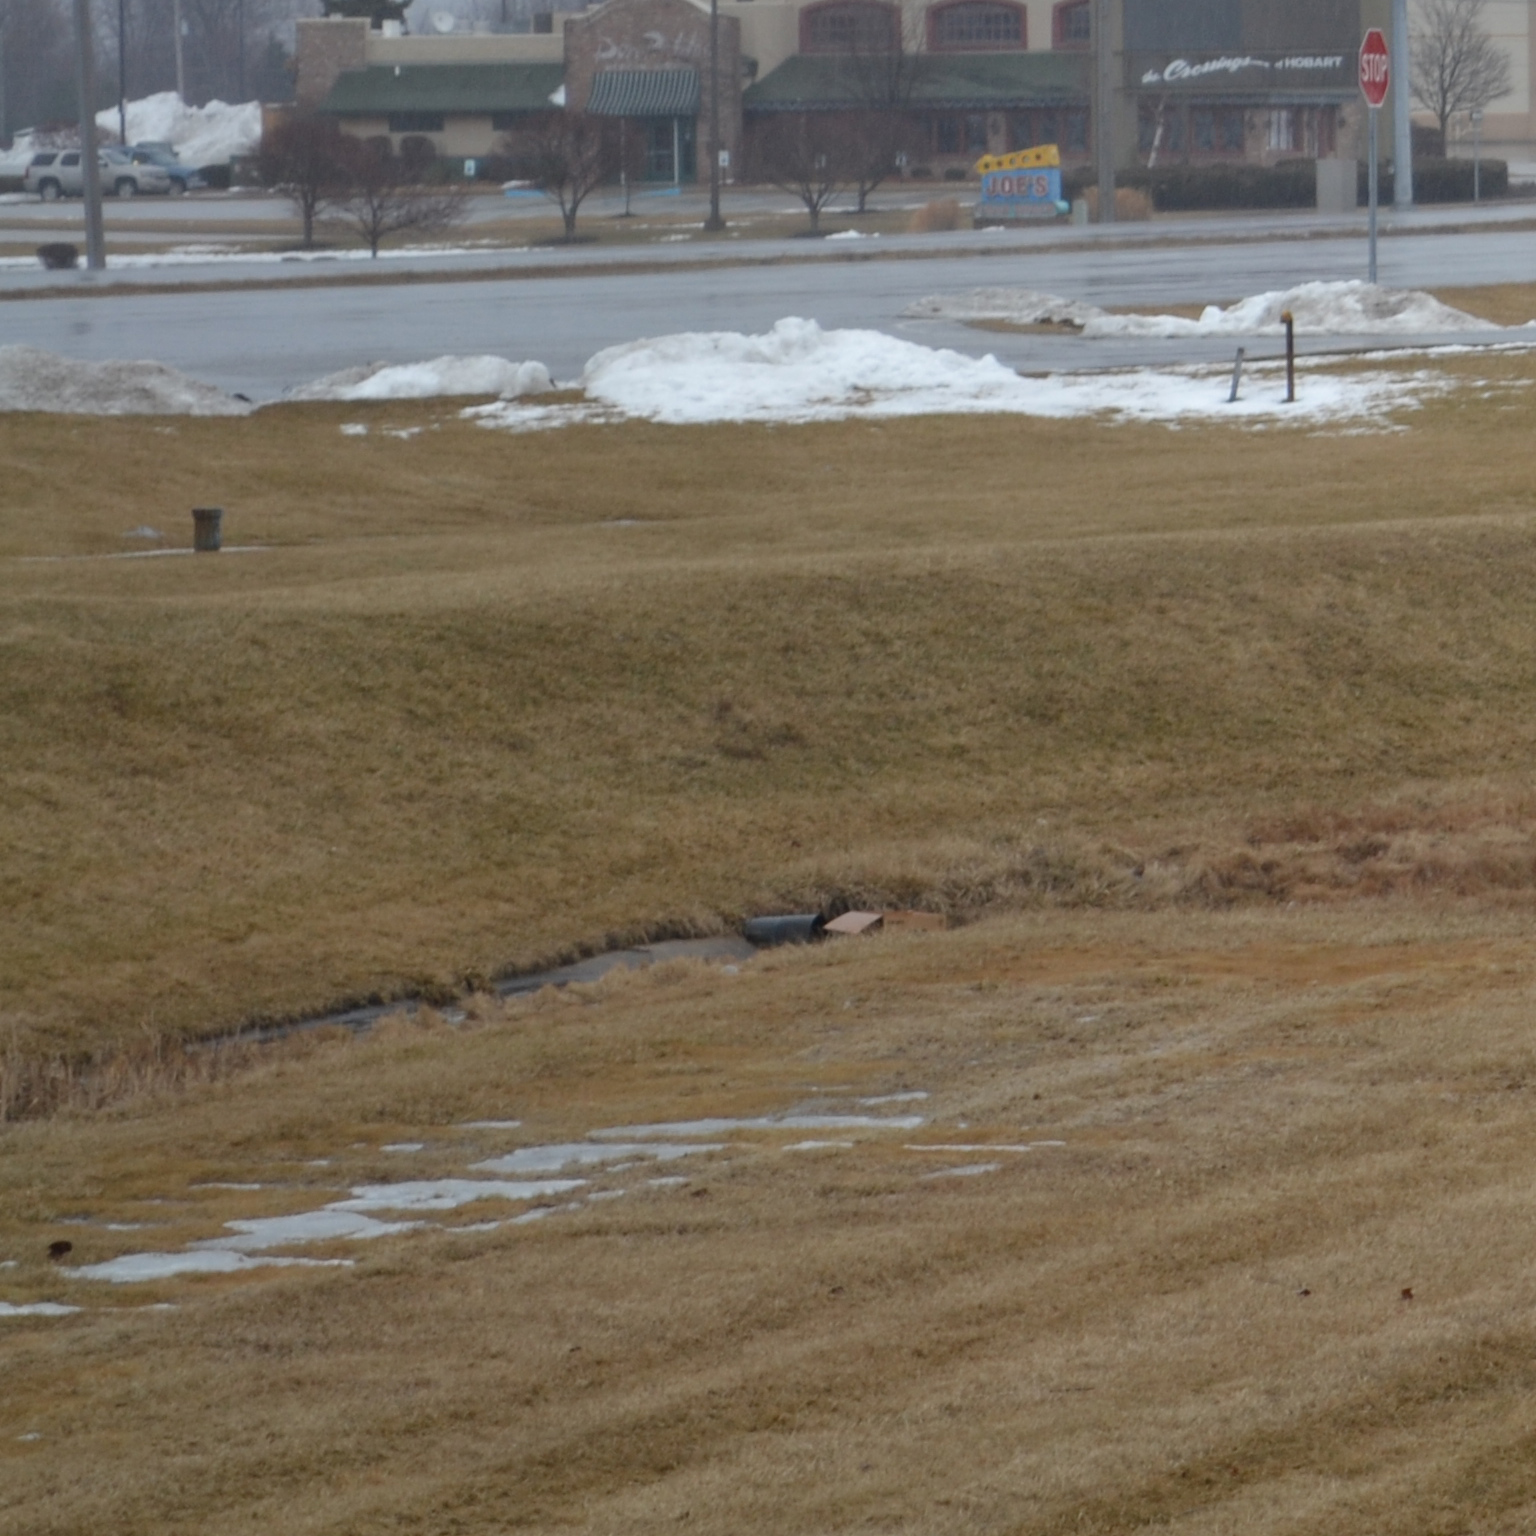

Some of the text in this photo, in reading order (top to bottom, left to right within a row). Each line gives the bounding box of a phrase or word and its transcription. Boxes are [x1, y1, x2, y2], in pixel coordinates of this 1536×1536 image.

[1285, 56, 1343, 69] HOBART
[1361, 54, 1387, 81] STOP
[986, 175, 1049, 197] JOE'S
